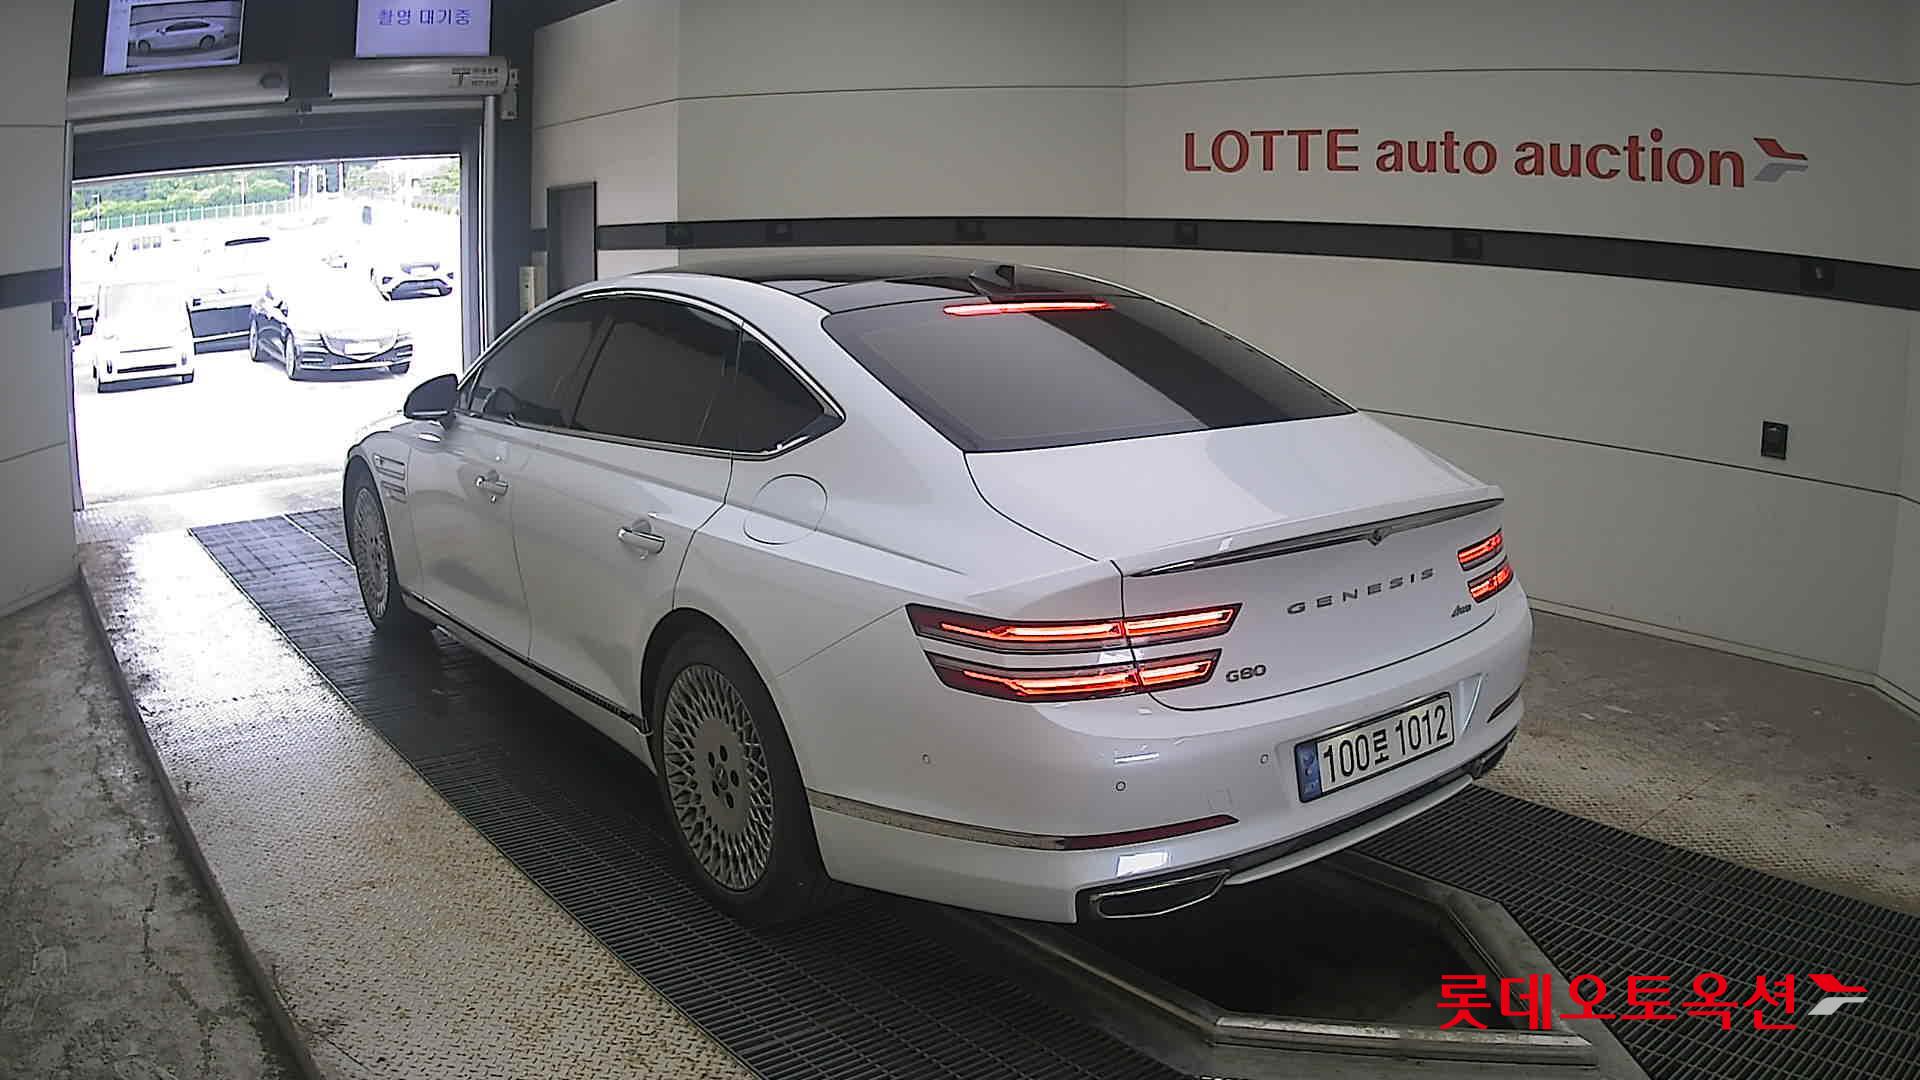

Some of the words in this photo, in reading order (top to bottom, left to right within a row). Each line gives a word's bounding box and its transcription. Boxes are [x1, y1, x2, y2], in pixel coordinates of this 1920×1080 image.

[419, 8, 471, 26] 대기중
[1184, 128, 1360, 173] LOTTE
[1376, 130, 1499, 176] auto
[1514, 127, 1746, 189] auction
[1286, 567, 1435, 616] GENESIS
[1225, 663, 1268, 684] G80
[1322, 728, 1390, 784] 100로
[1395, 704, 1449, 756] 1012
